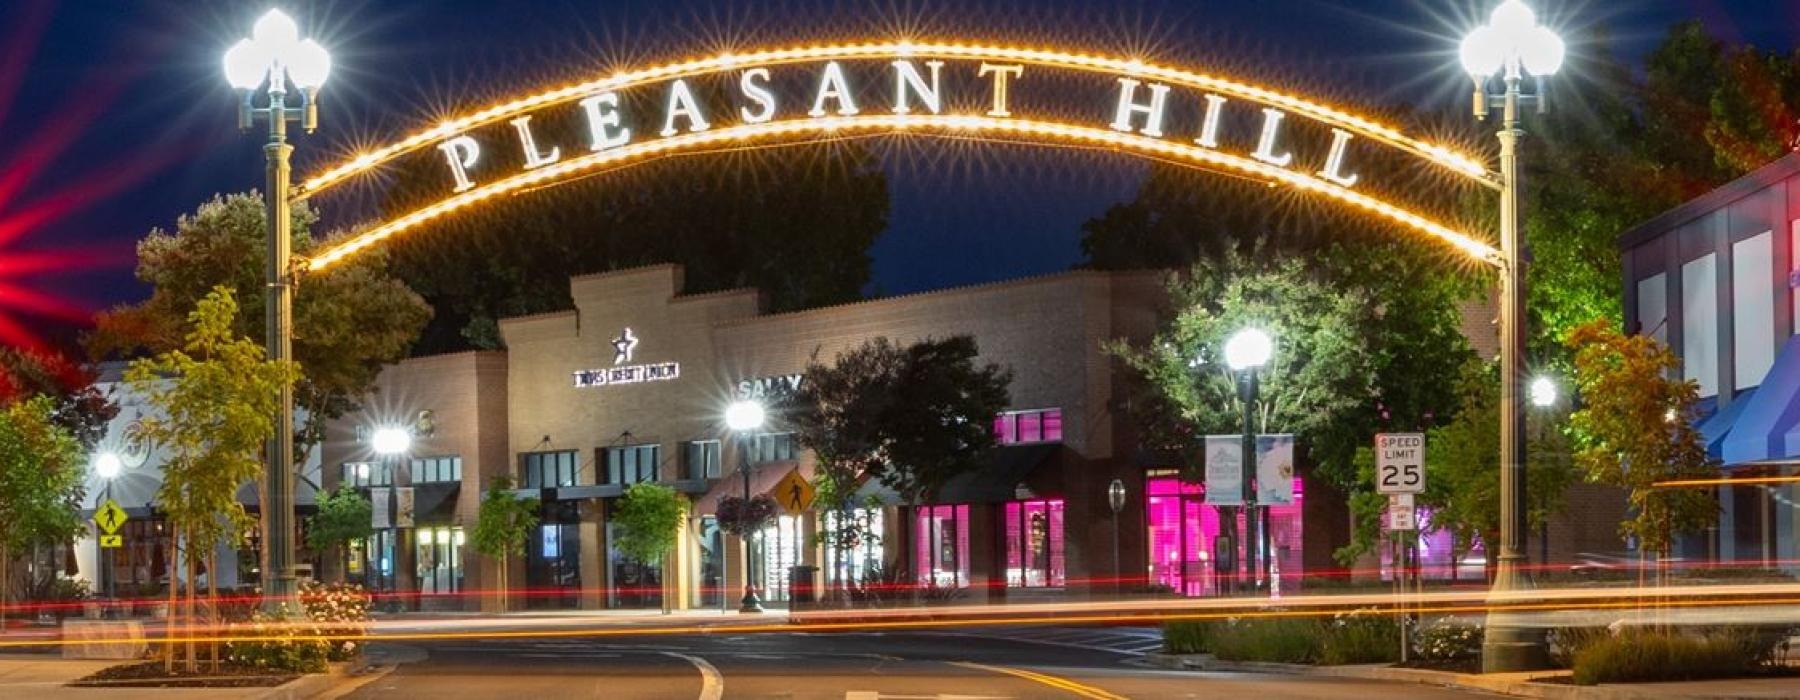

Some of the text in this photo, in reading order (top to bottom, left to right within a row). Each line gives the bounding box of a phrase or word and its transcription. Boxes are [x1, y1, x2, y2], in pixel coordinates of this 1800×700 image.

[437, 60, 1359, 193] PLEASANT HILL
[738, 374, 802, 399] SAY
[1381, 437, 1420, 448] SPEED
[1385, 450, 1416, 459] LIMIT
[1382, 465, 1420, 486] 25
